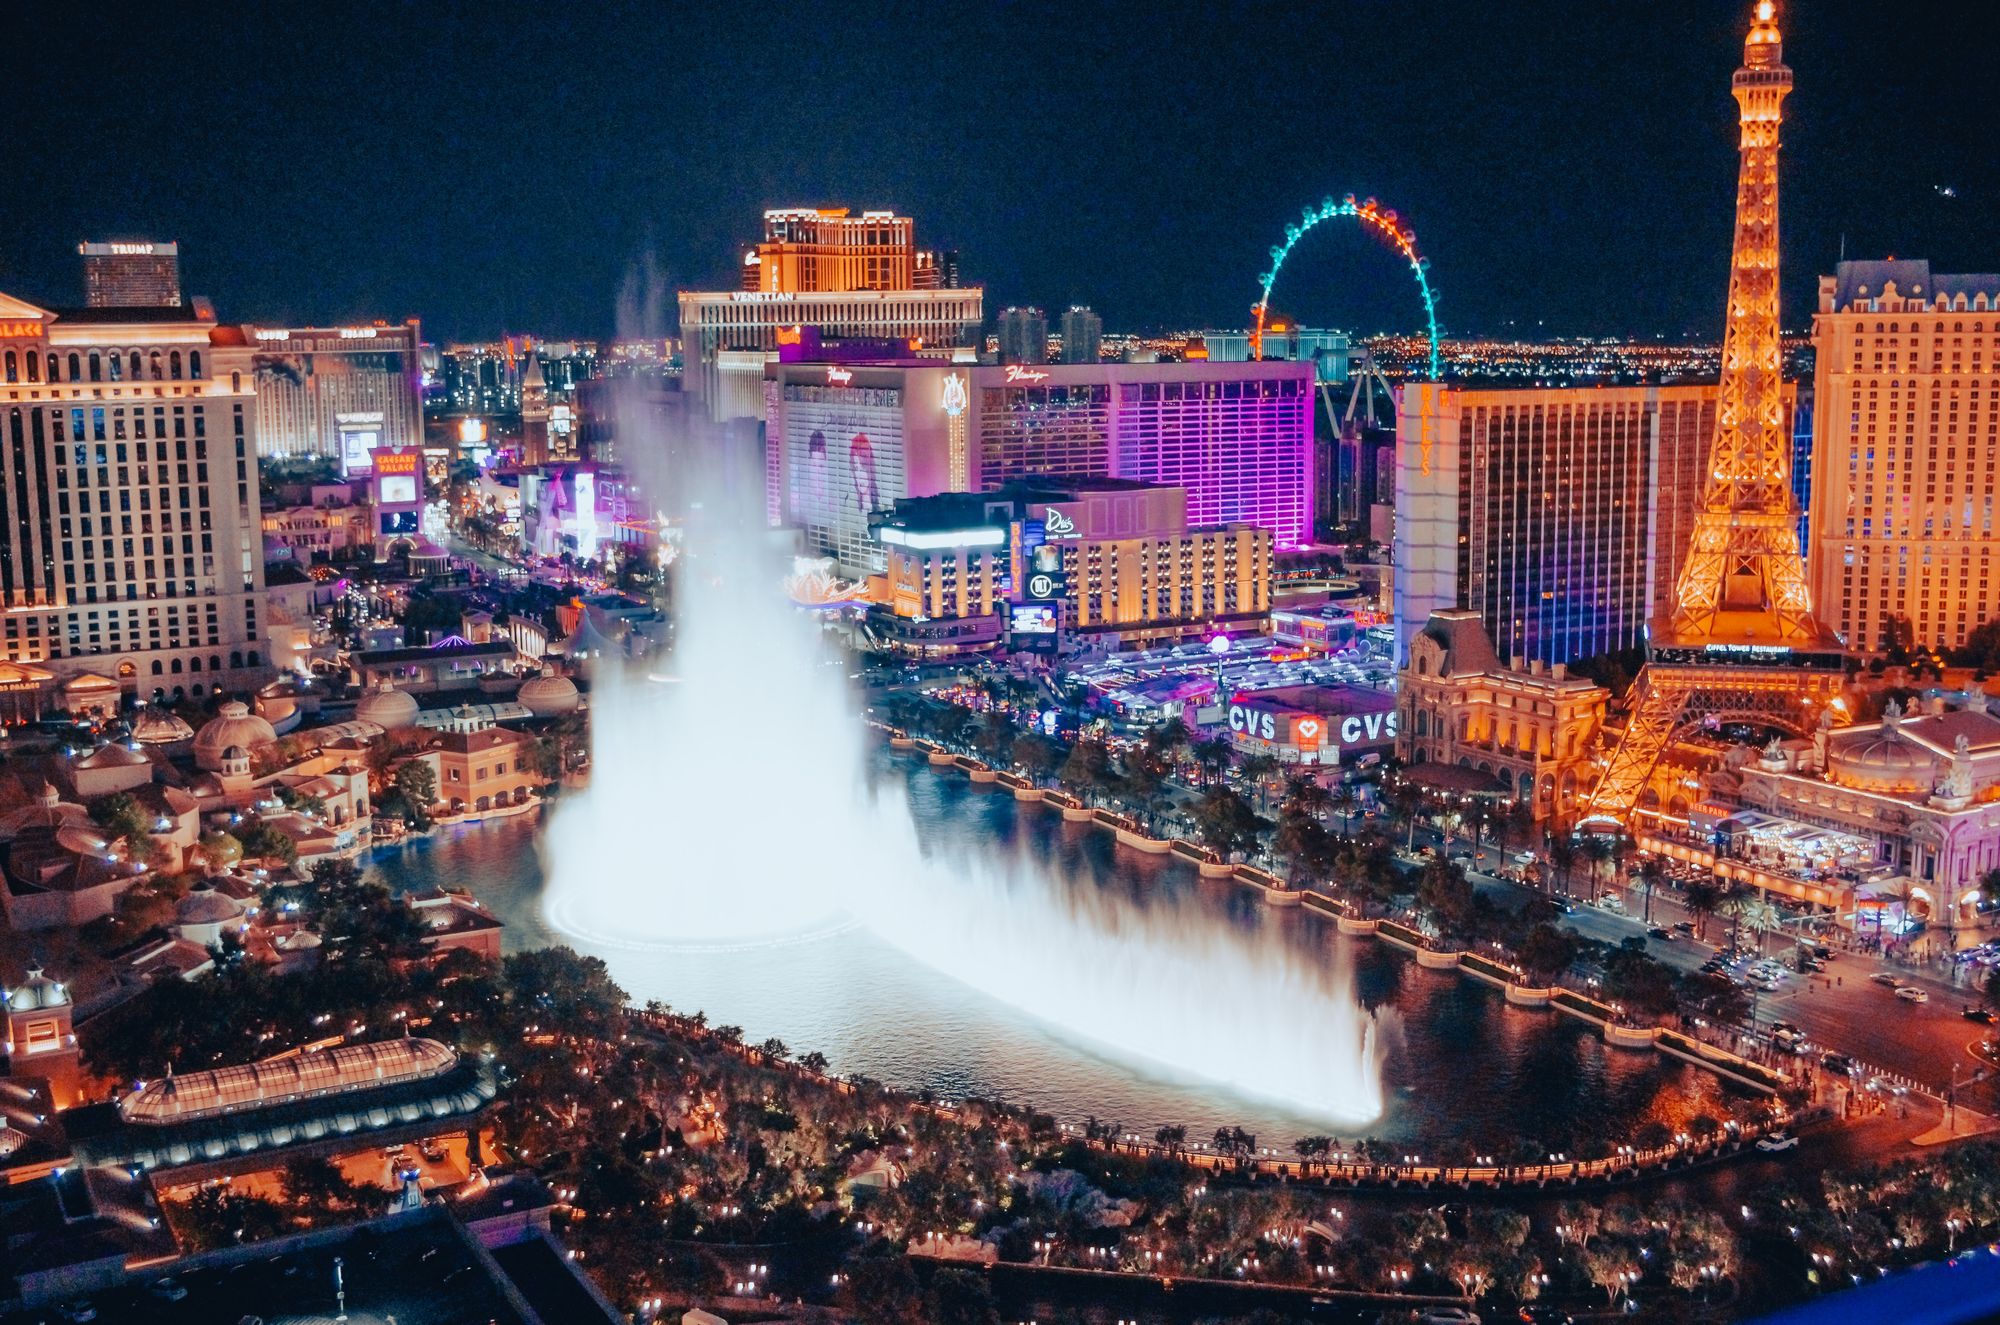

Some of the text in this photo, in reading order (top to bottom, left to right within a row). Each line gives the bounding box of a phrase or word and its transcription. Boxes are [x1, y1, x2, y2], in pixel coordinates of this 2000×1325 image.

[111, 244, 154, 254] TRUMP
[732, 291, 794, 302] VENETIAN
[827, 366, 853, 385] Flamingo
[1005, 365, 1049, 383] Flamingo
[377, 454, 417, 463] CAESARS
[379, 463, 415, 473] PALACE
[1706, 643, 1790, 653] EIFFEL TOWER RESTAURANT
[1228, 705, 1276, 740] CVS
[1341, 711, 1397, 744] CVS
[1690, 802, 1728, 817] BEER PARK
